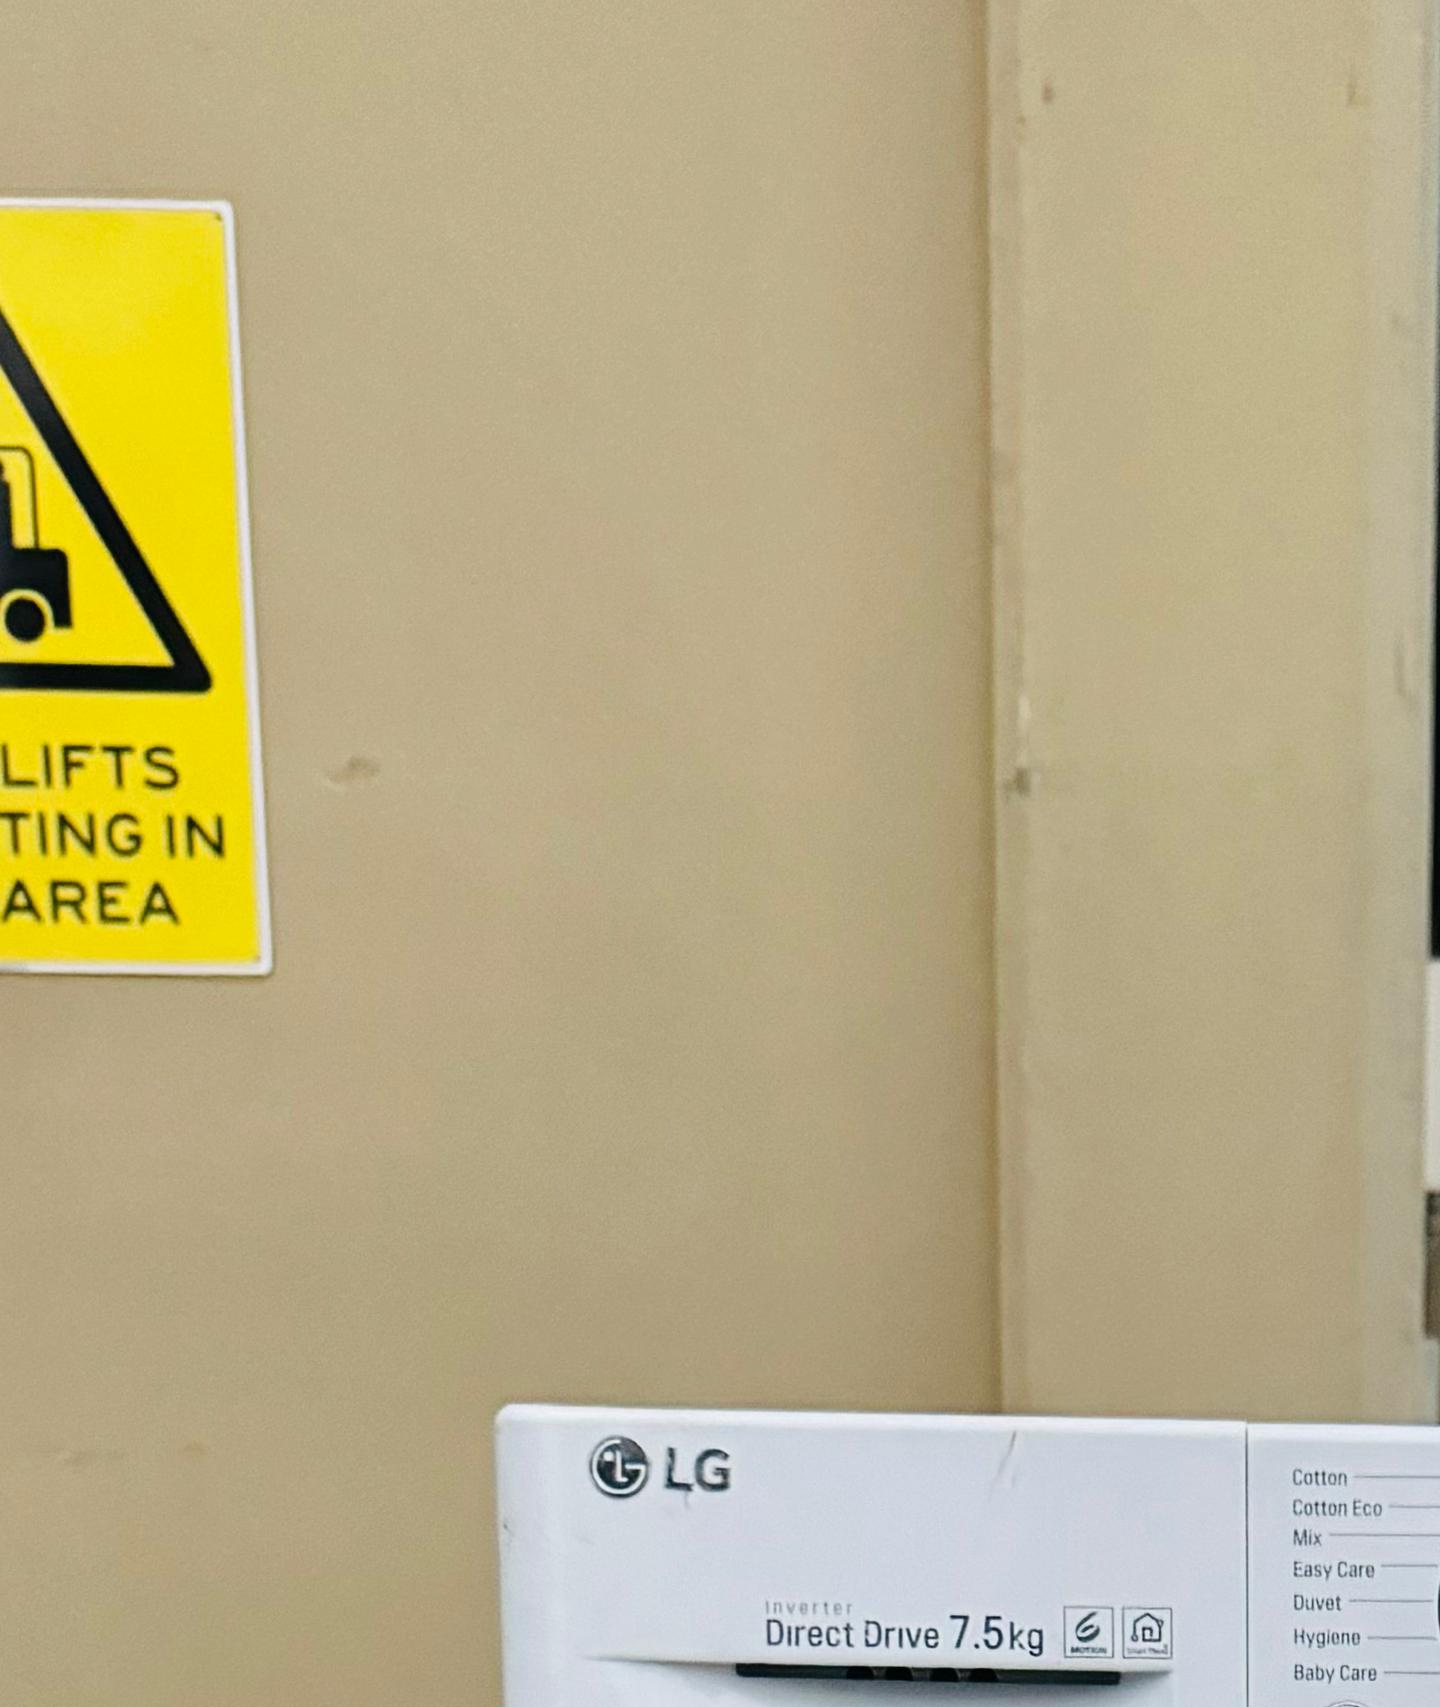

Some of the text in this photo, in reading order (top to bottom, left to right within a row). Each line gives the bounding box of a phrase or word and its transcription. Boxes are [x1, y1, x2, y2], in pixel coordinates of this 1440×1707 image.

[1, 744, 179, 789] LIFTS
[0, 812, 224, 857] TING IN
[2, 880, 180, 924] AREA
[664, 1447, 731, 1491] LG
[1292, 1469, 1348, 1486] Cotton
[1292, 1499, 1383, 1517] Cotton Eco
[1293, 1529, 1322, 1546] Mix
[1293, 1561, 1375, 1581] Easy Care
[1294, 1594, 1342, 1611] Duvet
[766, 1619, 854, 1648] Direct
[864, 1621, 939, 1649] Drive
[1294, 1629, 1361, 1648] Hygiene
[1294, 1665, 1377, 1684] Baby Care
